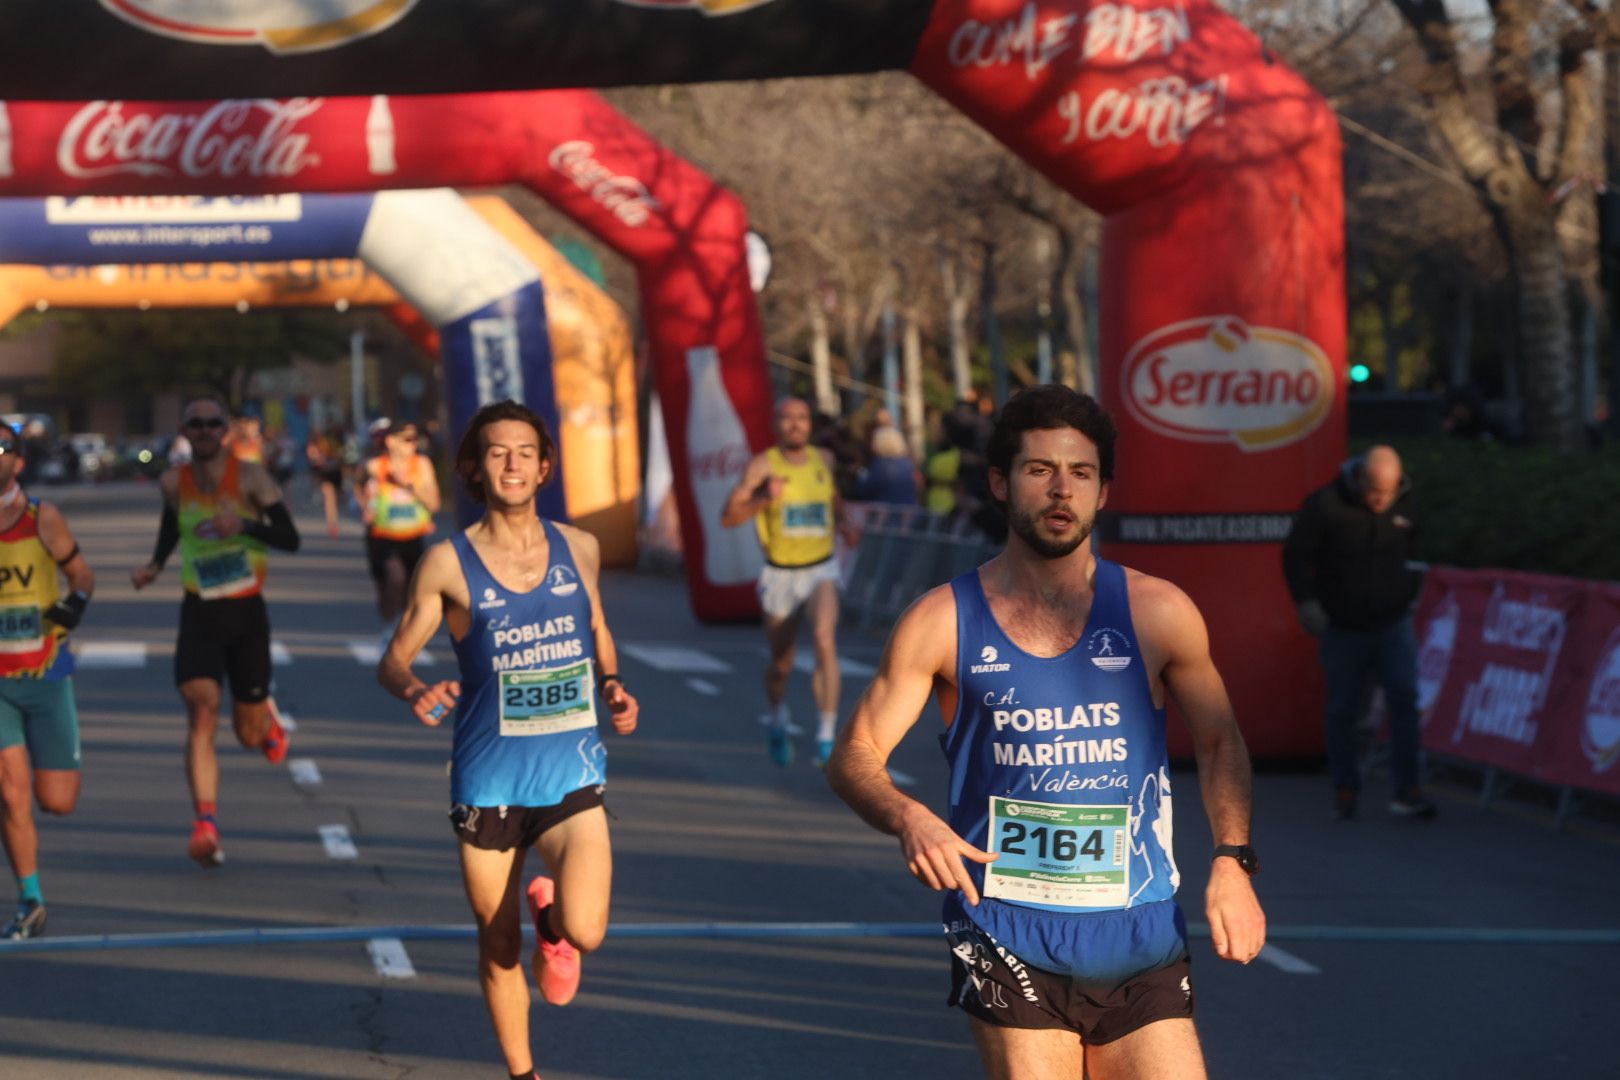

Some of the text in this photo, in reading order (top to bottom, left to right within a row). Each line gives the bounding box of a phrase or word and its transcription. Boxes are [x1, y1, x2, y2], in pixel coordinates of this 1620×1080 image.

[1080, 2, 1191, 63] BIEN
[88, 215, 271, 245] www.intersport.es
[1145, 354, 1319, 408] Serrano
[494, 615, 576, 648] POBLATS
[492, 640, 583, 672] MARÍTIMS
[970, 663, 1011, 675] VIATOR
[505, 680, 579, 708] 2385
[993, 702, 1121, 733] POBLATS
[993, 735, 1128, 767] MARÍTIMS
[1030, 768, 1129, 792] València
[1000, 821, 1105, 862] 2164
